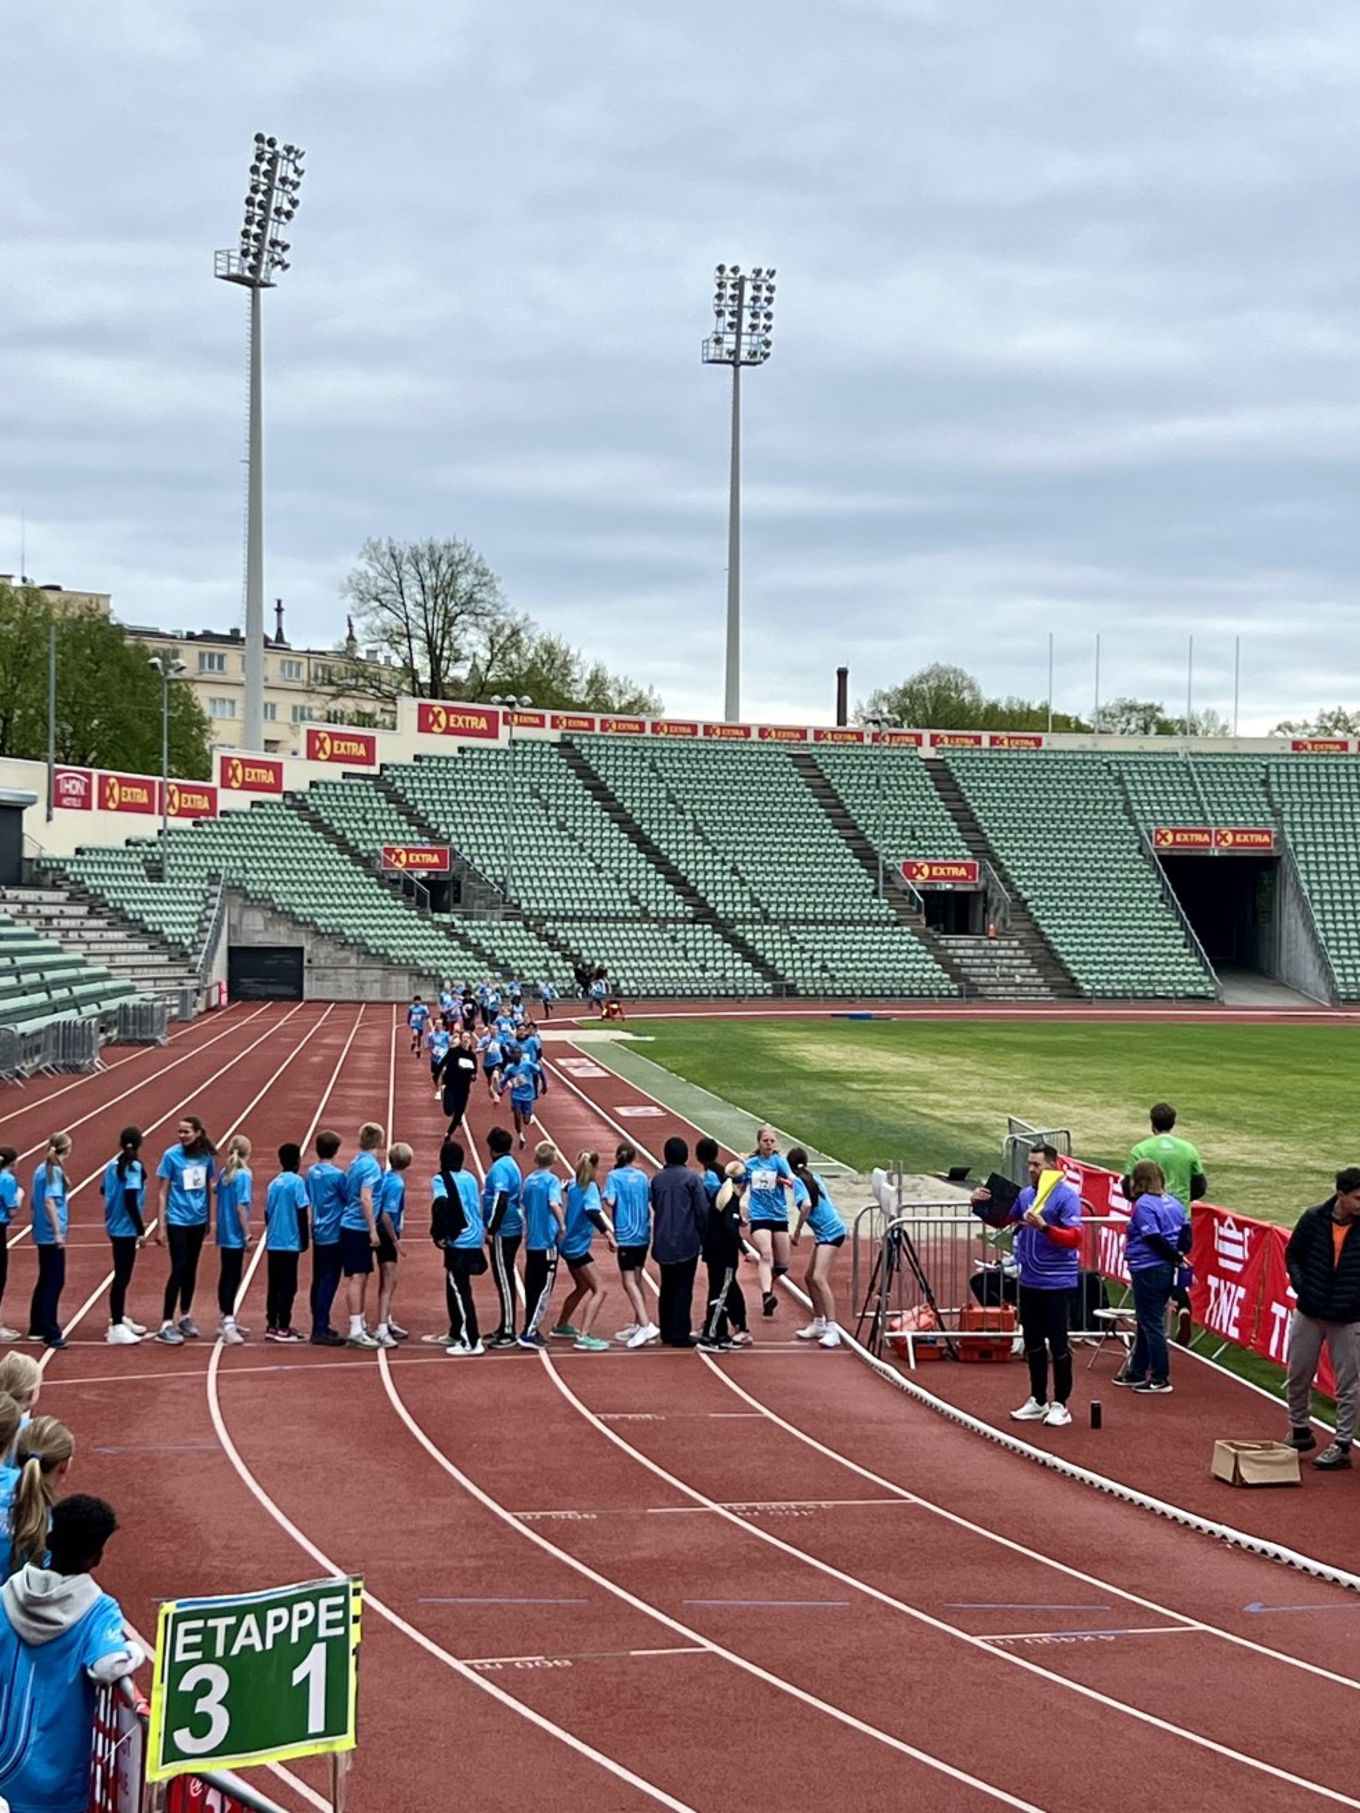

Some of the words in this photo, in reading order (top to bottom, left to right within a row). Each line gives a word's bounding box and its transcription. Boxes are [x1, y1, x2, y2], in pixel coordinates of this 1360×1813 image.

[449, 714, 488, 730] EXTRA
[333, 740, 366, 756] EXTRA
[244, 768, 275, 784] EXTRA
[121, 787, 149, 804] EXTRA
[181, 794, 210, 810] EXTRA
[1175, 833, 1210, 843] EXTRA
[1235, 833, 1270, 843] EXTRA
[408, 853, 440, 864] EXTRA
[932, 866, 967, 876] EXTRA
[175, 1596, 345, 1662] ETAPPE
[173, 1663, 230, 1755] 3
[292, 1641, 327, 1734] 1
